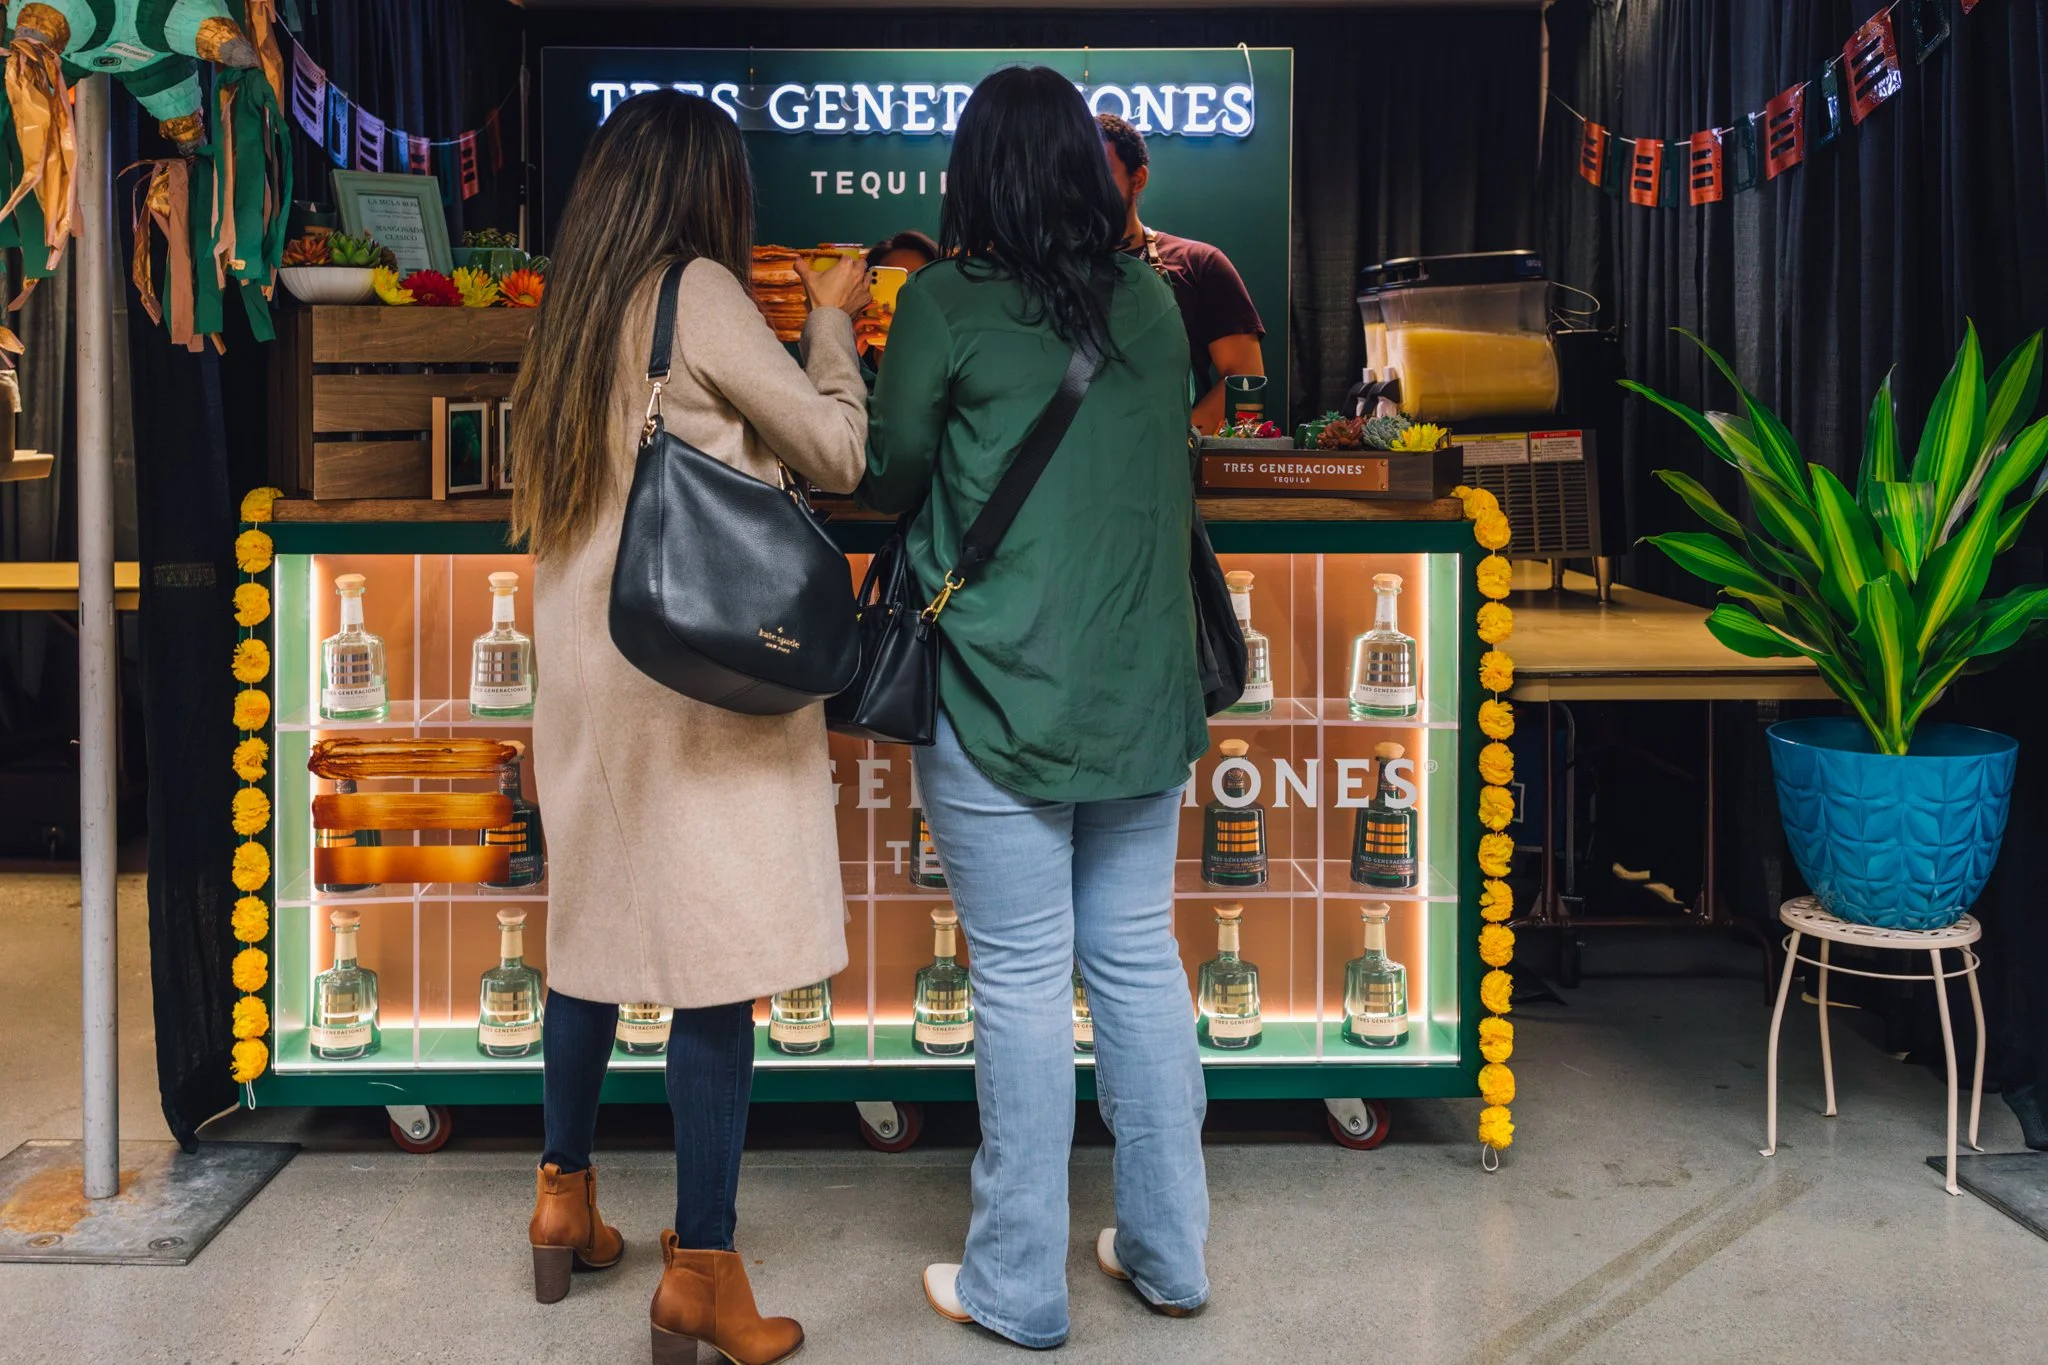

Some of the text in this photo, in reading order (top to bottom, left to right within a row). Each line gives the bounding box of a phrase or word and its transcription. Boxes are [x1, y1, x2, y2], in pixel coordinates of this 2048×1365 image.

[590, 83, 1252, 133] TS GENERONES
[811, 171, 947, 199] TEQUI
[1223, 462, 1363, 475] TRES GENERACIONES
[1273, 476, 1311, 484] TEQUILA
[777, 637, 800, 649] spade
[337, 687, 382, 696] GENERACIONES
